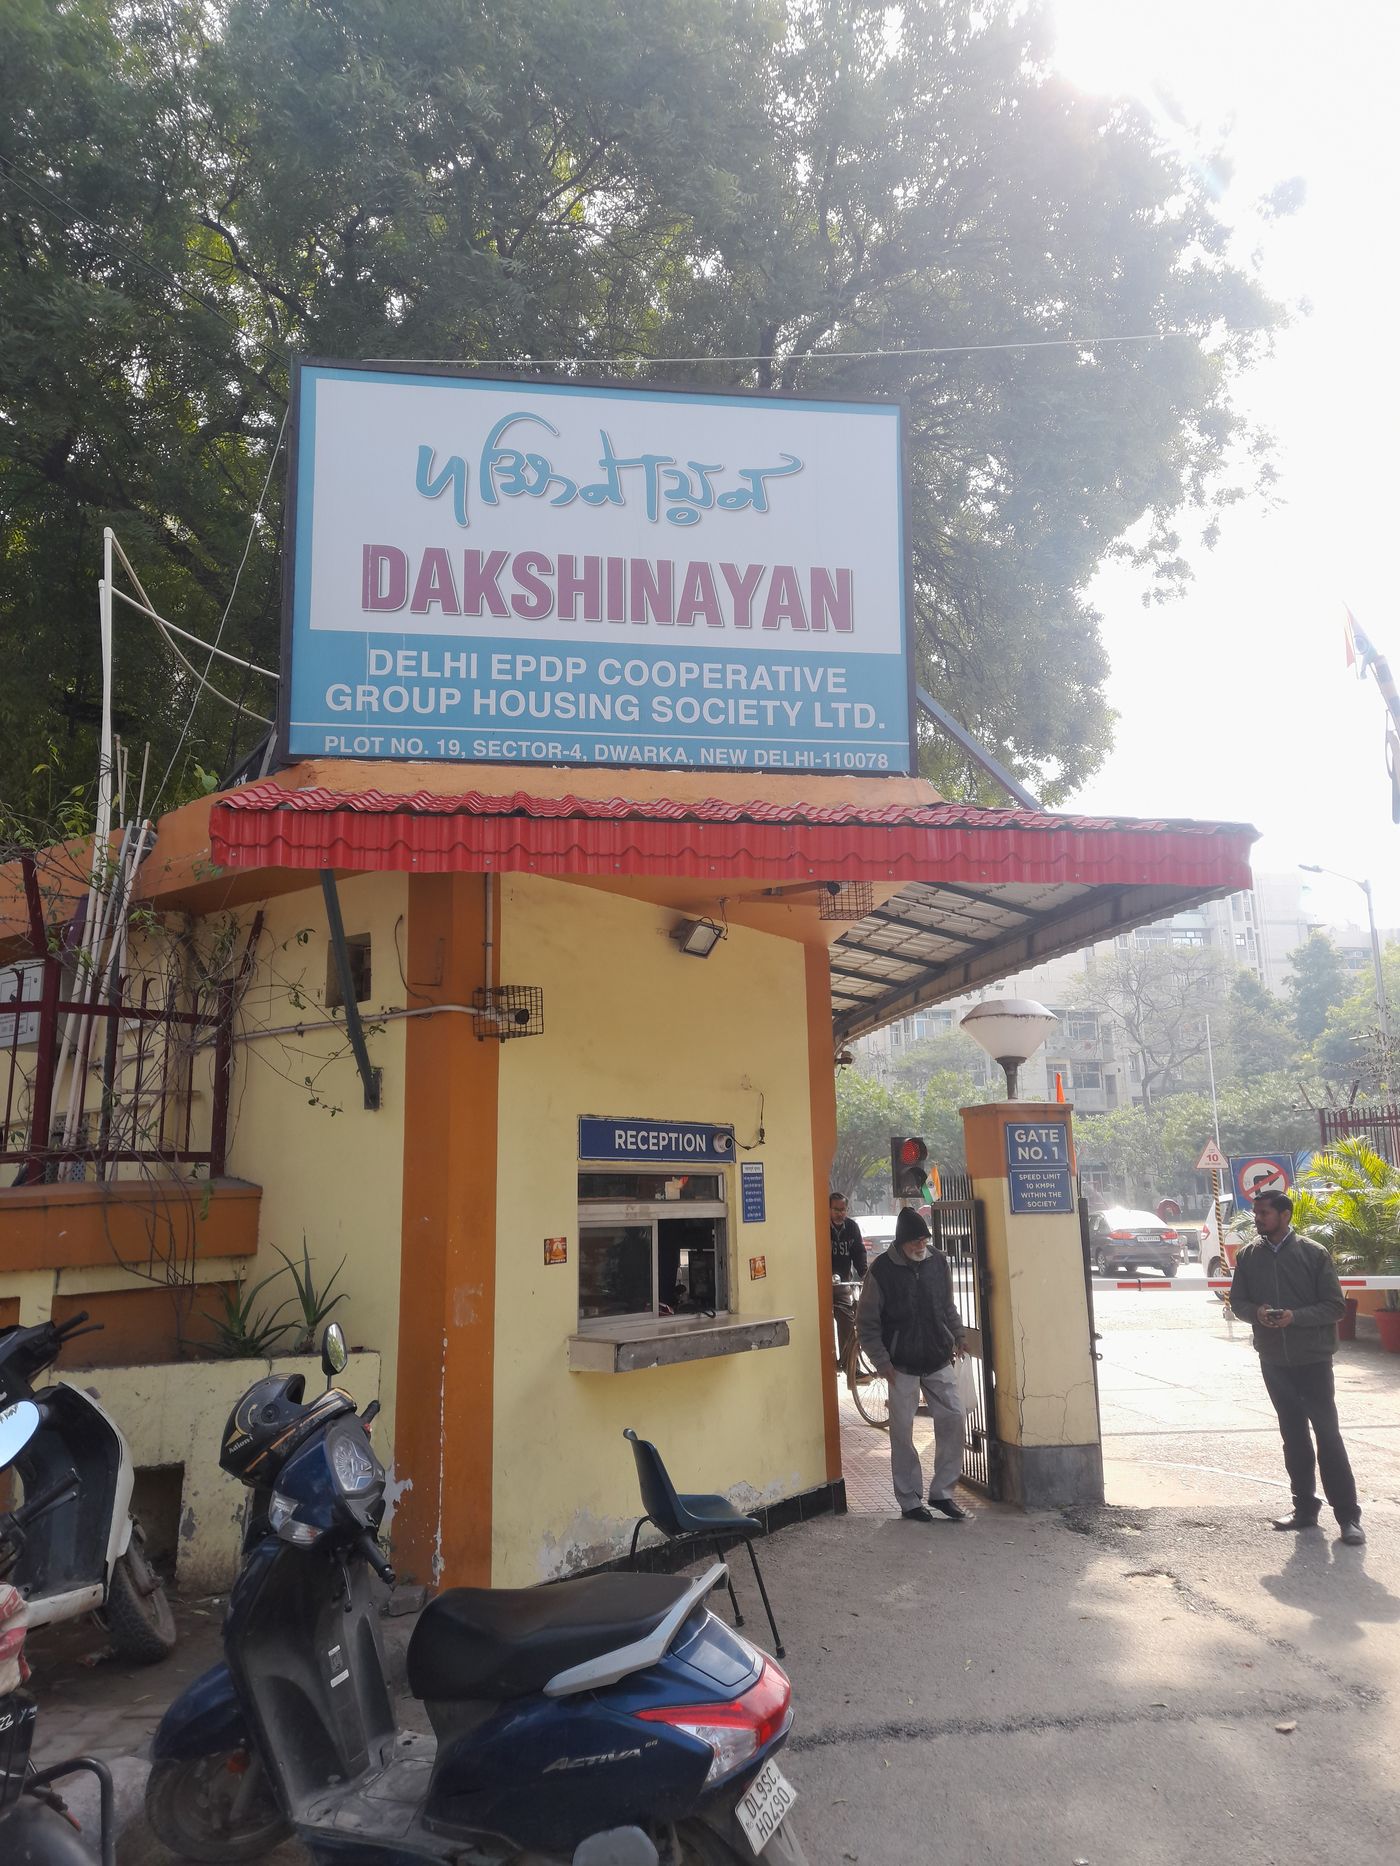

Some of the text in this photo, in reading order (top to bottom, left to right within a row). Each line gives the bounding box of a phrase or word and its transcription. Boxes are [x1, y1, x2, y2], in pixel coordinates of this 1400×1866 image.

[361, 543, 854, 632] DAKSHINAYAN
[368, 649, 848, 693] DELHI EPDP COOPERATIVE
[325, 683, 886, 729] GROUP HOUSING SOCIETY LTD.
[324, 735, 889, 769] PLOT NO. 19, SECTOR-4, DWARKA, NEW DELHI-110078
[614, 1129, 707, 1152] RECEPTION
[1014, 1129, 1060, 1143] GATE
[1018, 1146, 1059, 1160] NO. 1
[1206, 1153, 1219, 1162] 10
[1019, 1173, 1041, 1181] SPEED
[1027, 1200, 1057, 1208] SOCIETY
